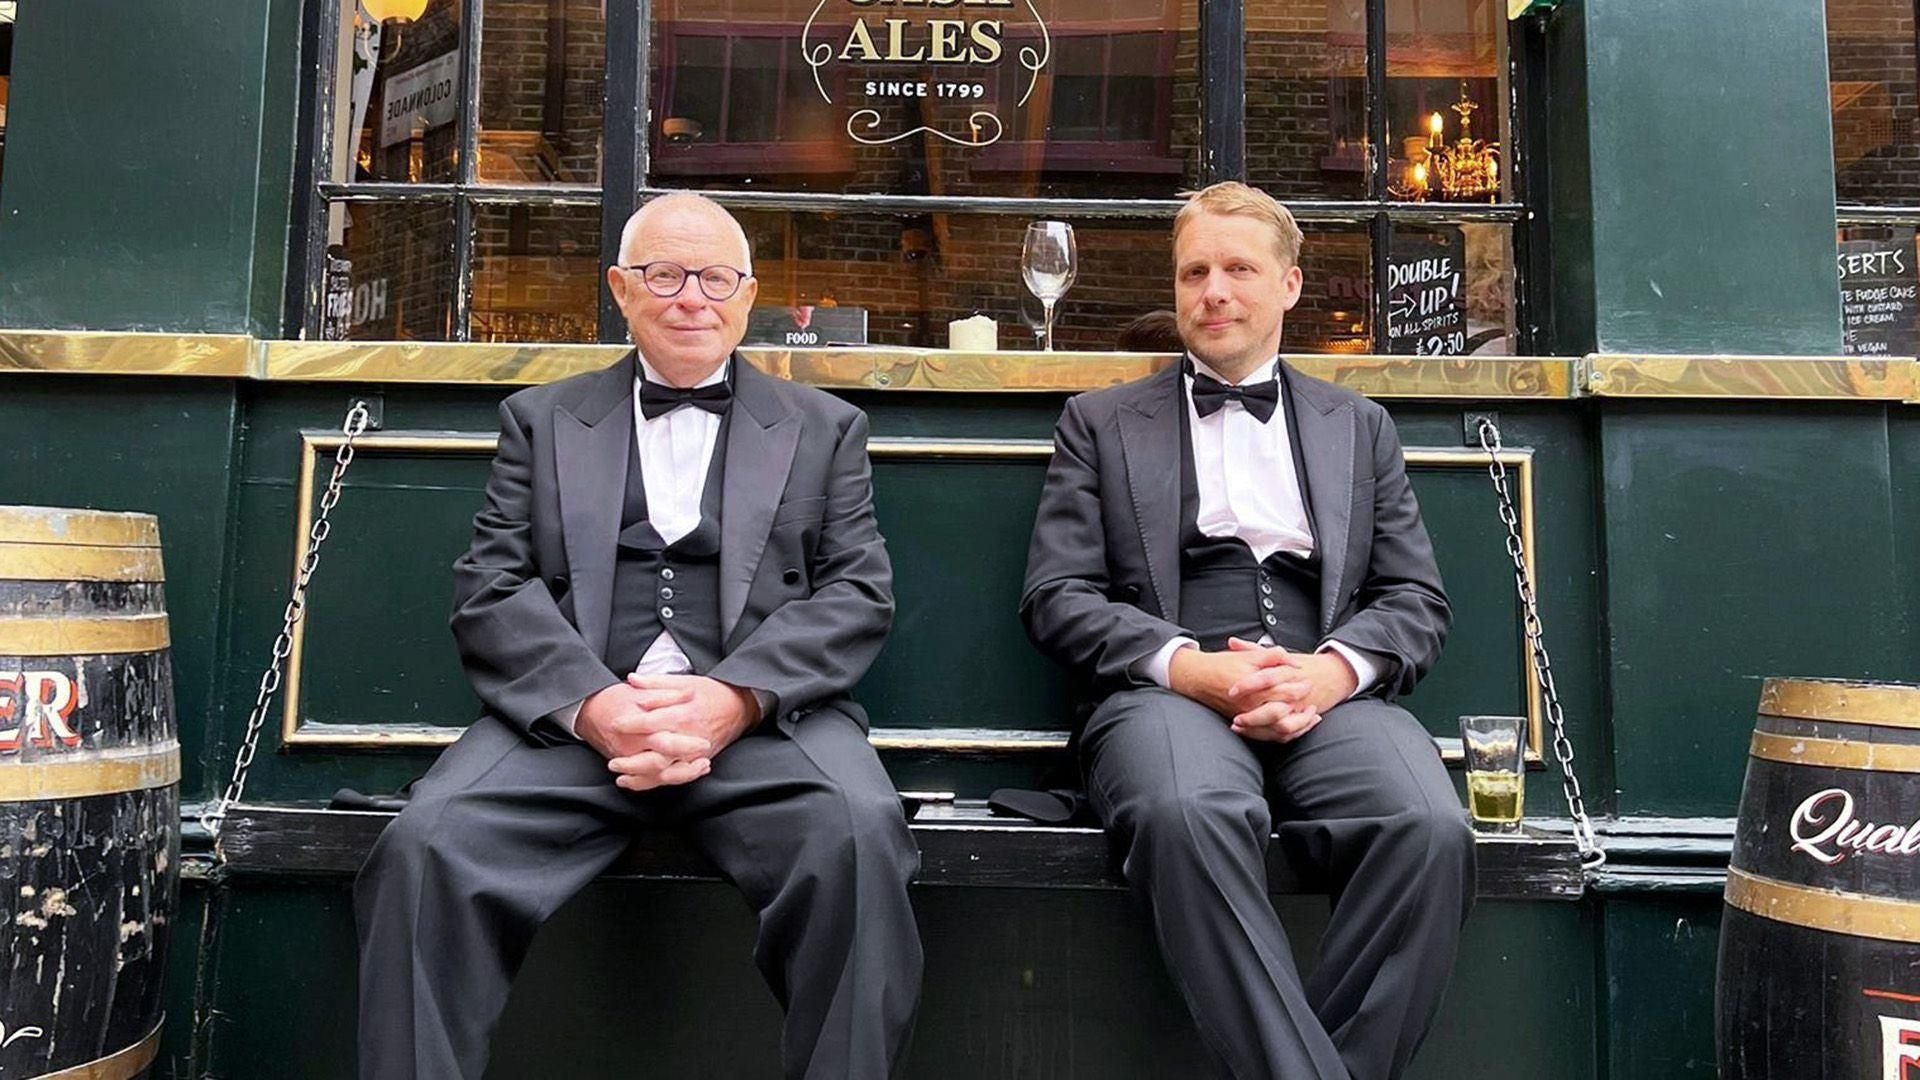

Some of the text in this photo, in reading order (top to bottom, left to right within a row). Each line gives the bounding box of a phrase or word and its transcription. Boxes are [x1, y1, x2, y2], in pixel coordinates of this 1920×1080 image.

[838, 18, 1003, 64] ALES
[865, 81, 985, 98] SINCE 1799
[1388, 258, 1451, 291] DOUBLE
[1837, 249, 1905, 279] SERTS
[1419, 272, 1460, 316] UP!
[1855, 288, 1888, 302] FUDGE
[1889, 286, 1917, 299] CAKE
[1403, 325, 1421, 335] ALL
[1422, 312, 1459, 332] SPIRITS
[786, 332, 818, 345] FOOD
[1857, 342, 1888, 353] VEGAN
